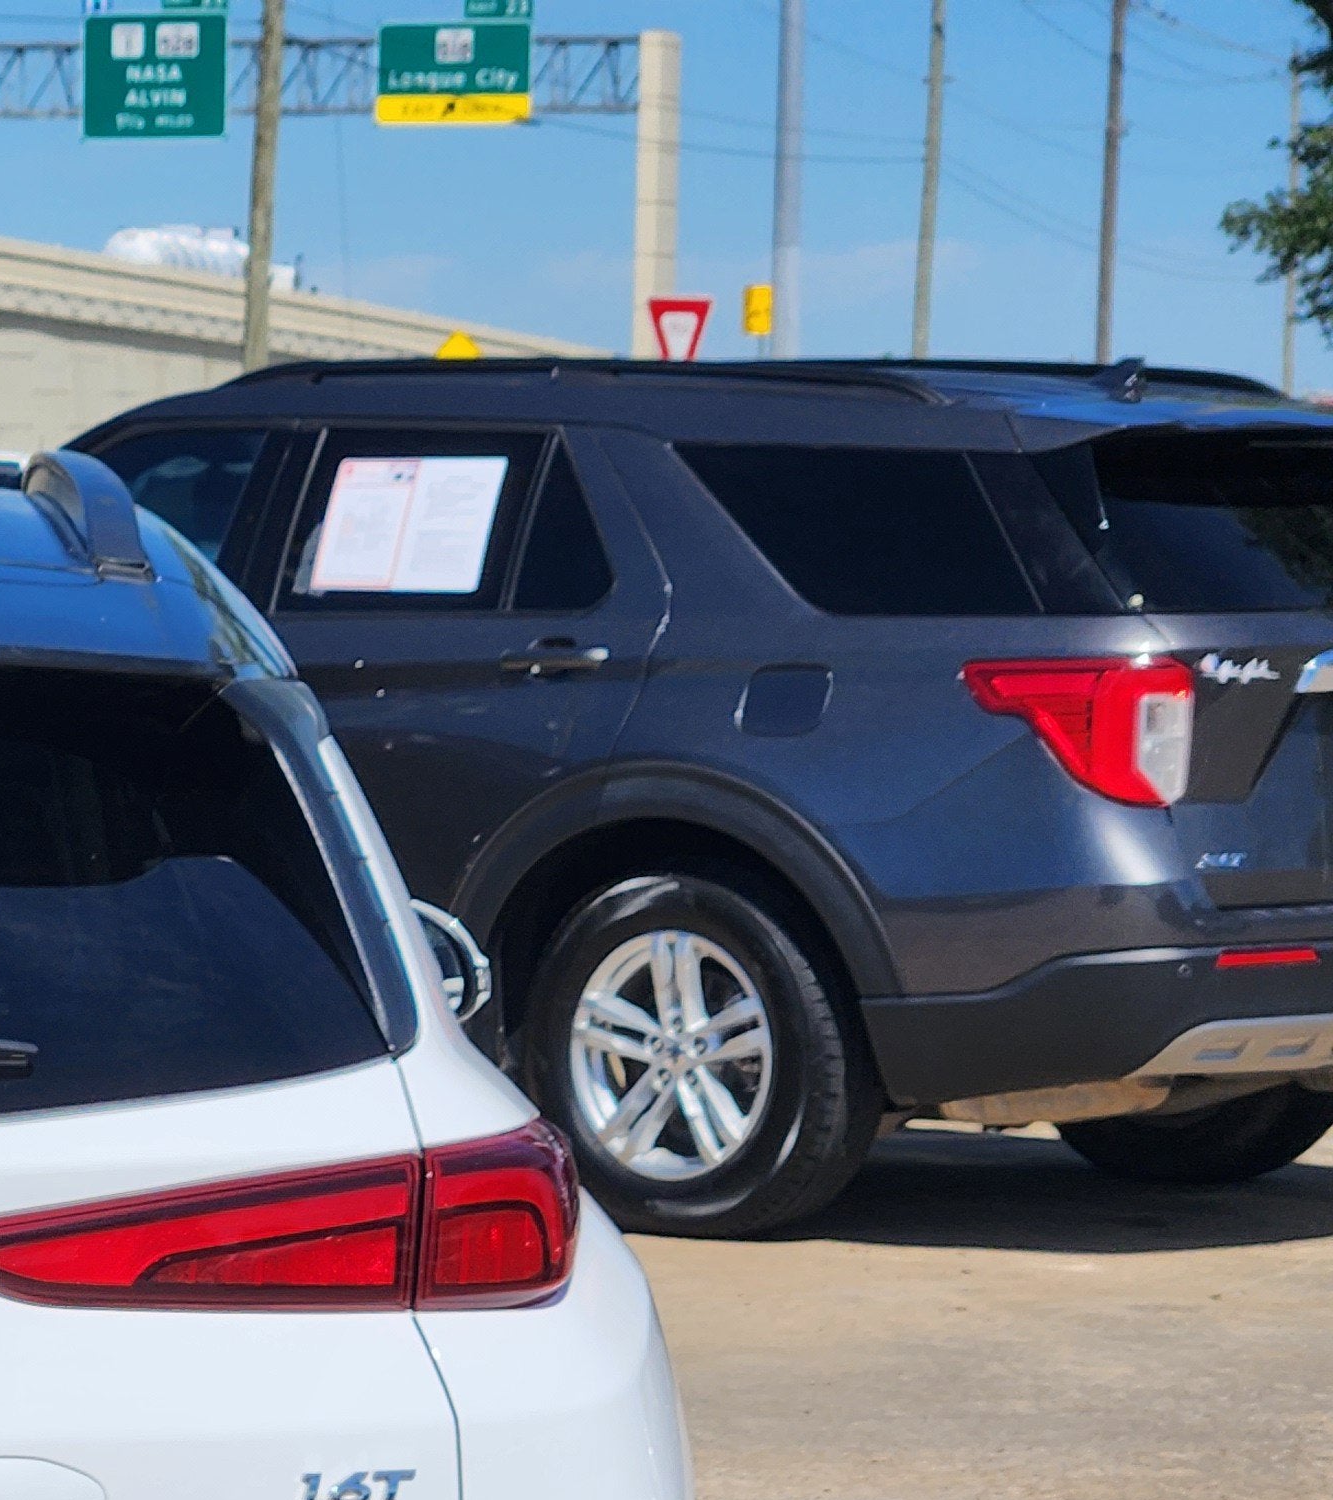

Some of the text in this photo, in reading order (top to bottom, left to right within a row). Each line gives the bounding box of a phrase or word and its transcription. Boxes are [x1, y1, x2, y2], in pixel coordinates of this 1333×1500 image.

[126, 63, 182, 83] NASA
[475, 66, 520, 91] City
[124, 88, 186, 108] ALVIN
